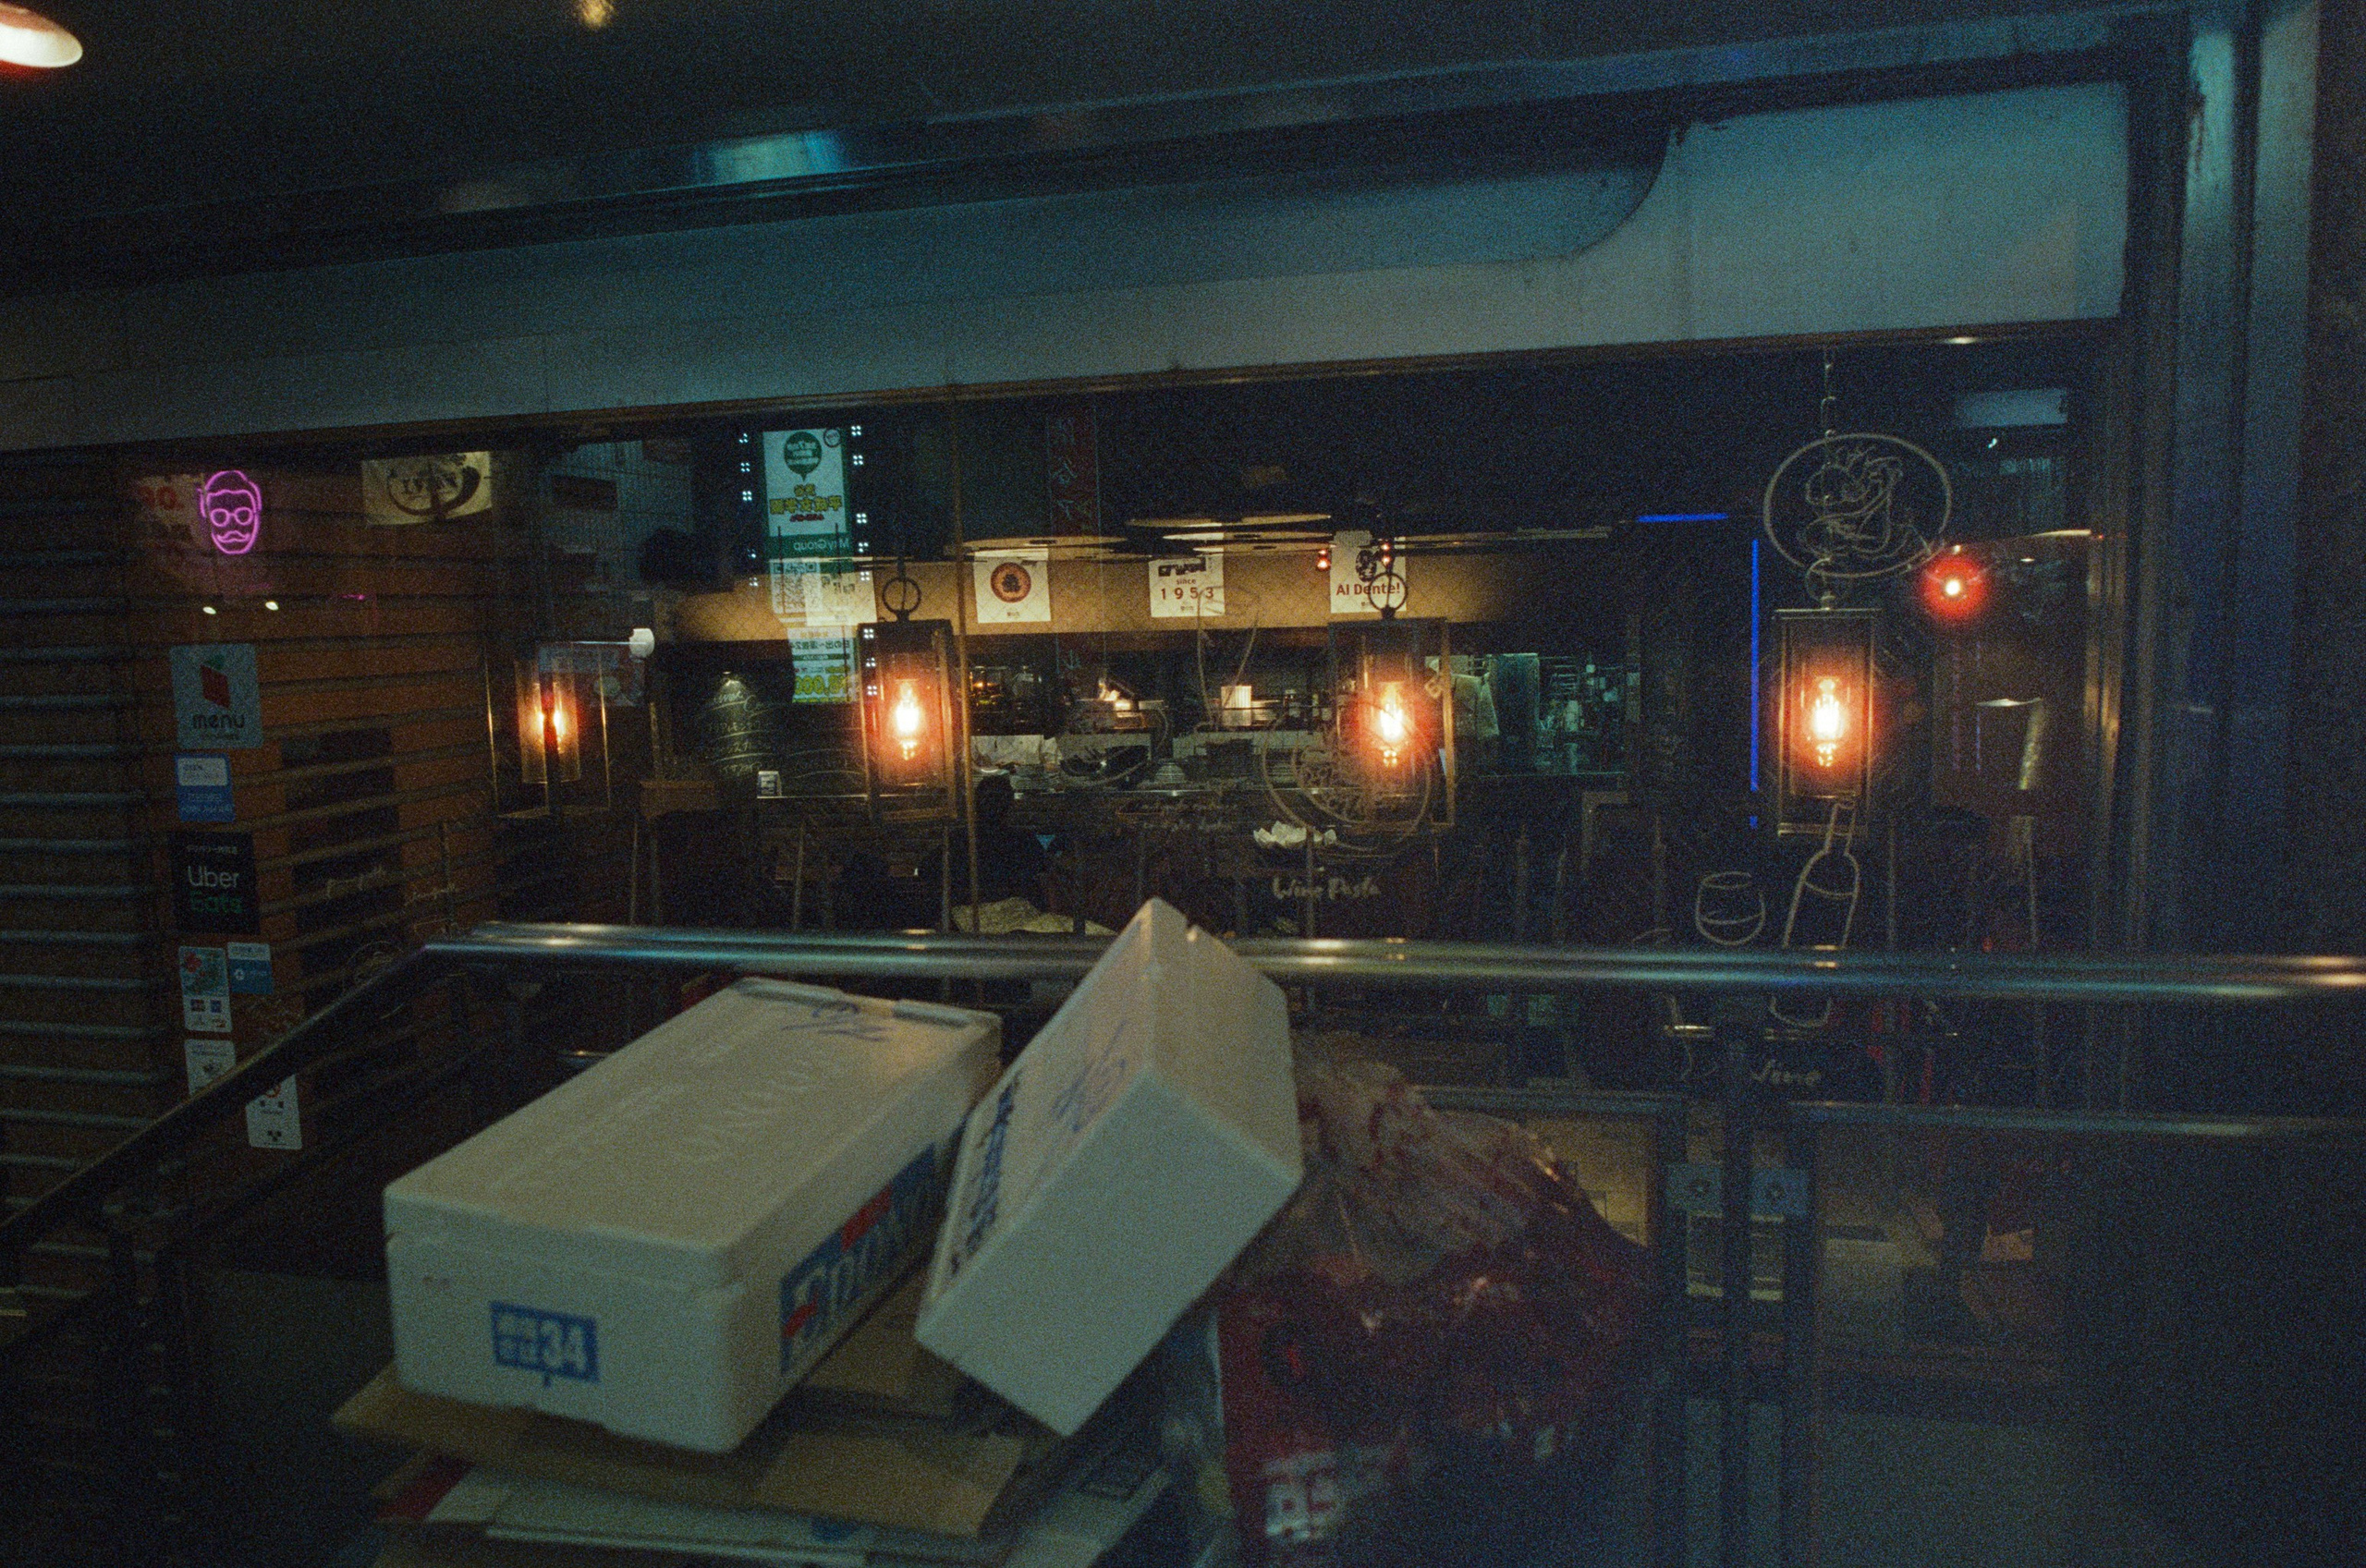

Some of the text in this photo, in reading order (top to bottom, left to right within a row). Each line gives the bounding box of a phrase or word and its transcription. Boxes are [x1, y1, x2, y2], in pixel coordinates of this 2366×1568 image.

[1335, 580, 1402, 597] Al Dente!
[191, 714, 246, 730] menu
[187, 865, 240, 889] Uber
[189, 889, 244, 915] Eats
[540, 1319, 587, 1373] 34
